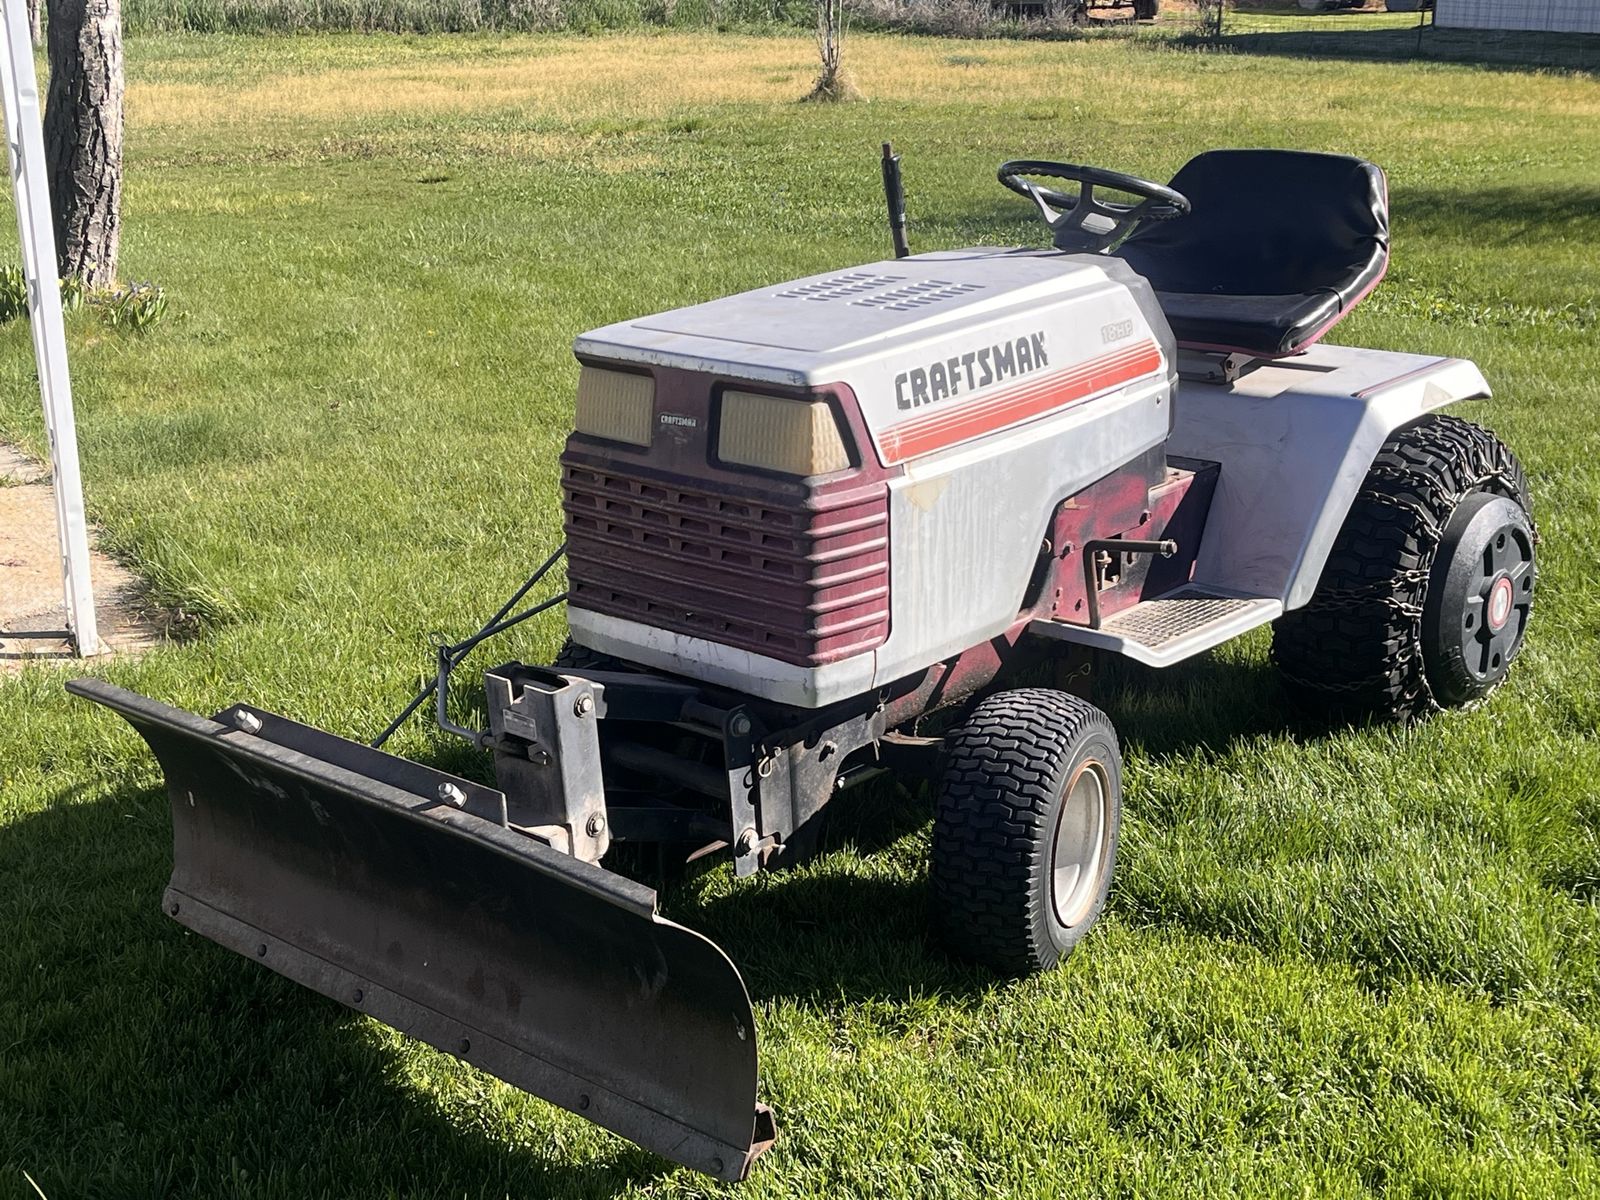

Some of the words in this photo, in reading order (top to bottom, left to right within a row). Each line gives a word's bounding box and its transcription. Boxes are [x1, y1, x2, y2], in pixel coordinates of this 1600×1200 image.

[1101, 319, 1133, 344] 18HP
[895, 331, 1048, 410] CRAFTSMAN
[661, 414, 697, 427] CRAFTSMAN
